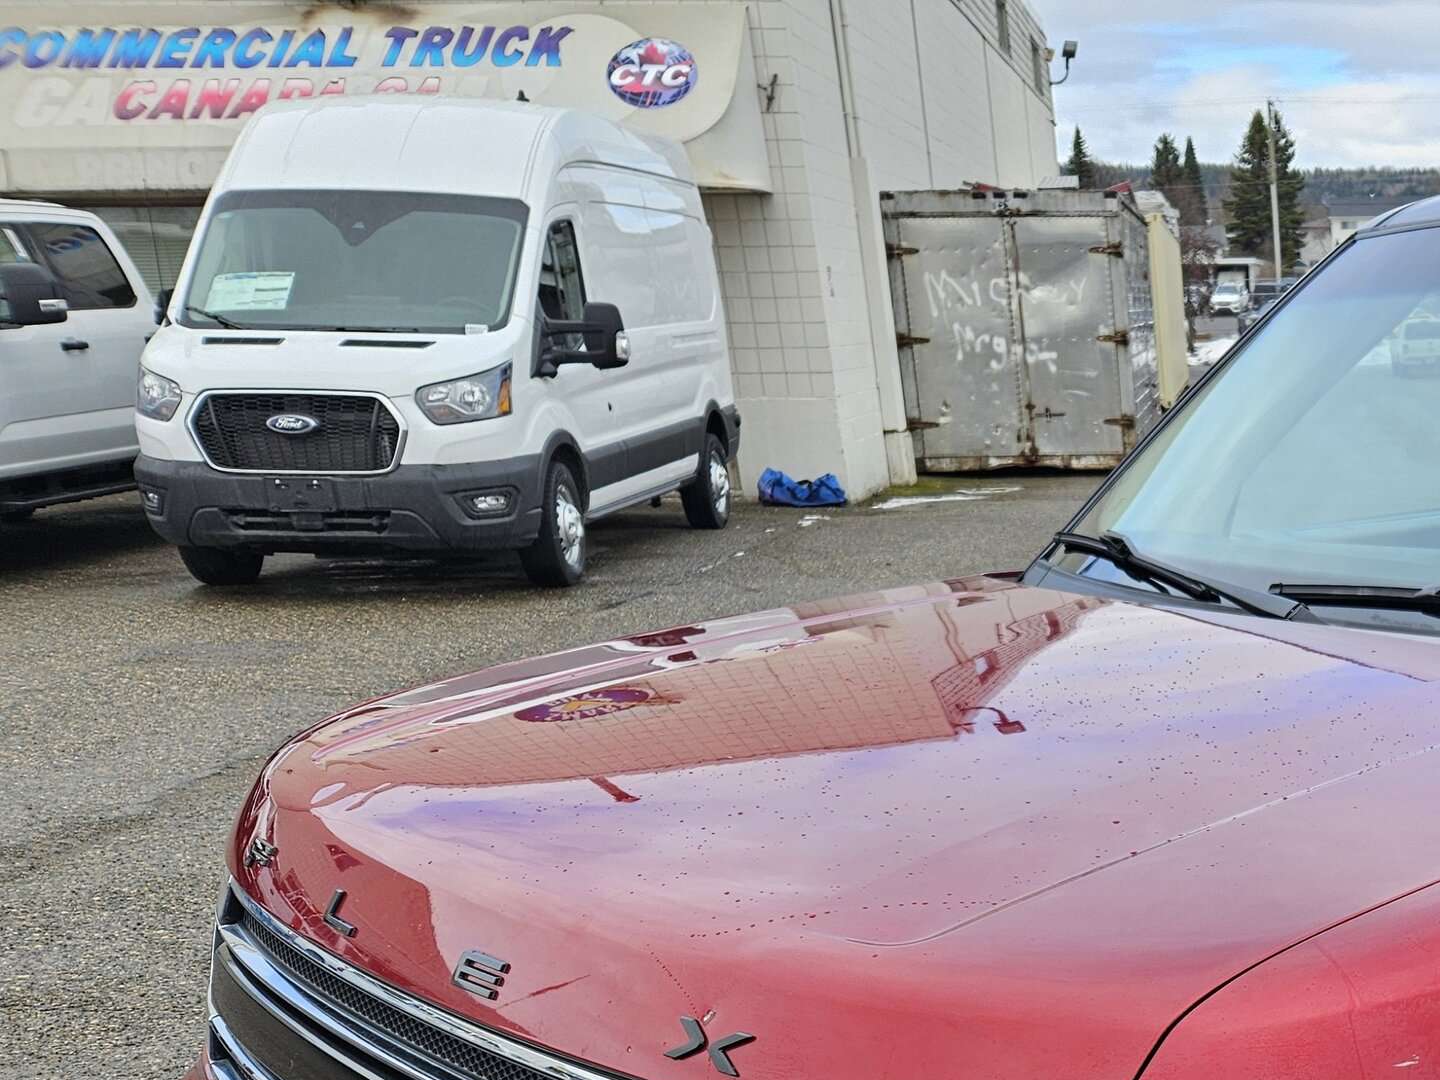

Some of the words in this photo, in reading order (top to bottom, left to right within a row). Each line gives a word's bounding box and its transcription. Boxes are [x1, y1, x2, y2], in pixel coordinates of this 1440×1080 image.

[0, 26, 359, 70] COMMERCIAL
[381, 26, 575, 68] TRUCK
[609, 63, 693, 88] CTC
